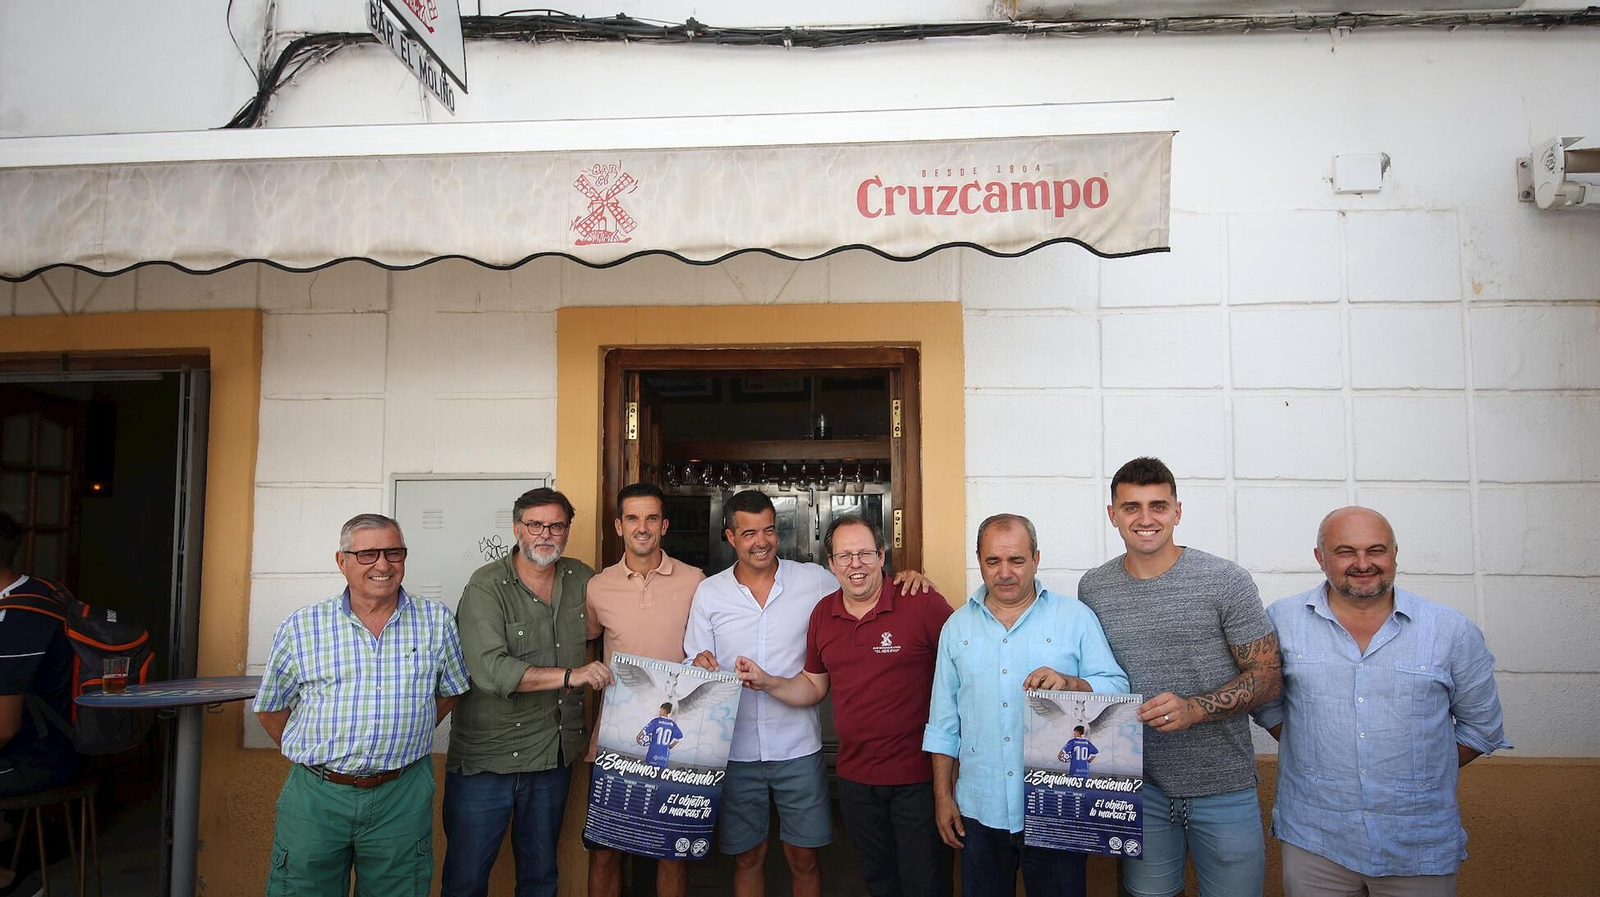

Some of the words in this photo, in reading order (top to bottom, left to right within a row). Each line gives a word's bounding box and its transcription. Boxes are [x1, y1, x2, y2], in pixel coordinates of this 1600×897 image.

[370, 0, 394, 50] BAR
[400, 33, 415, 70] EL
[419, 55, 455, 112] MOLINO
[592, 163, 618, 176] BAR
[921, 165, 977, 178] DESDE
[995, 163, 1040, 174] 1804
[856, 174, 1109, 219] Cruzcampo
[655, 726, 672, 746] 10
[1073, 746, 1089, 760] 10
[660, 767, 725, 786] creciendo?
[1085, 777, 1143, 793] creciendo?
[658, 803, 668, 814] lo
[667, 793, 679, 804] El
[678, 794, 711, 809] objetivo
[1094, 799, 1105, 809] El
[1104, 799, 1134, 813] objetivo
[1089, 807, 1098, 817] lo
[1097, 809, 1127, 821] marcas
